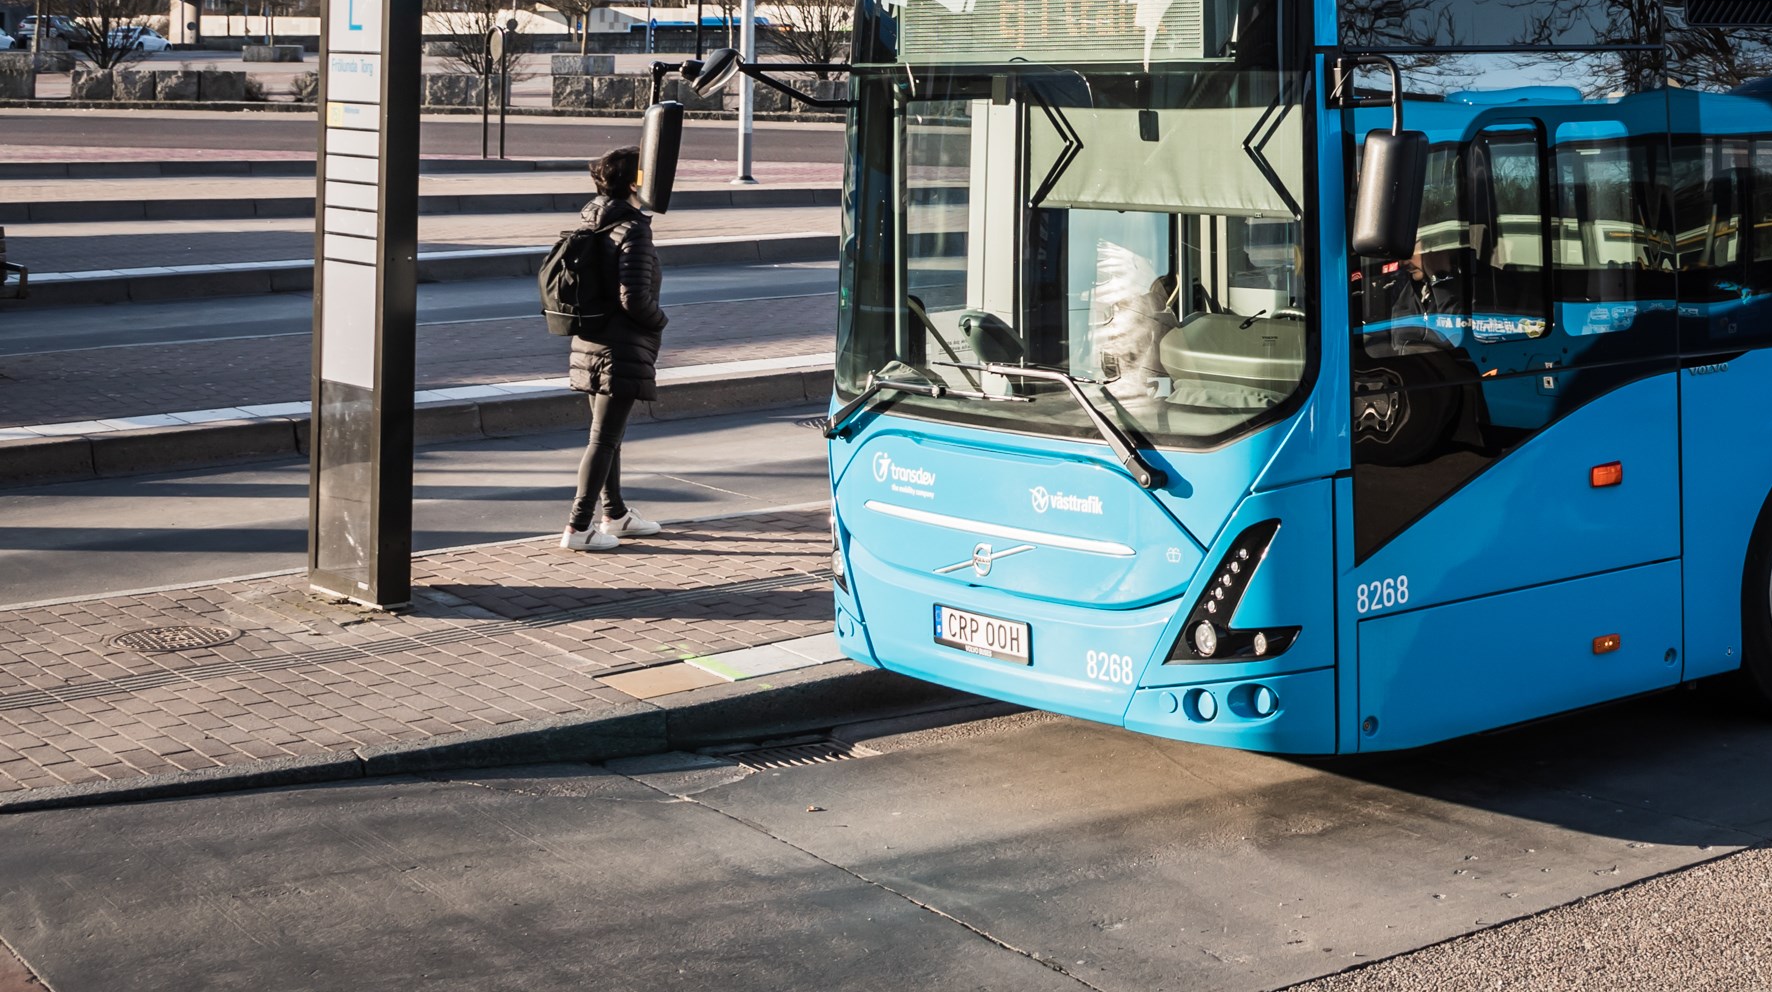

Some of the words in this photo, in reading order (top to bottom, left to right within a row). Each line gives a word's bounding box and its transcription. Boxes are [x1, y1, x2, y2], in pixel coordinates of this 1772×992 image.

[1688, 362, 1729, 377] VOLVO
[890, 463, 936, 487] transdev
[1050, 490, 1103, 515] västtrafik
[1356, 574, 1410, 614] 8268
[948, 612, 979, 643] CRP
[1086, 649, 1134, 685] 8268
